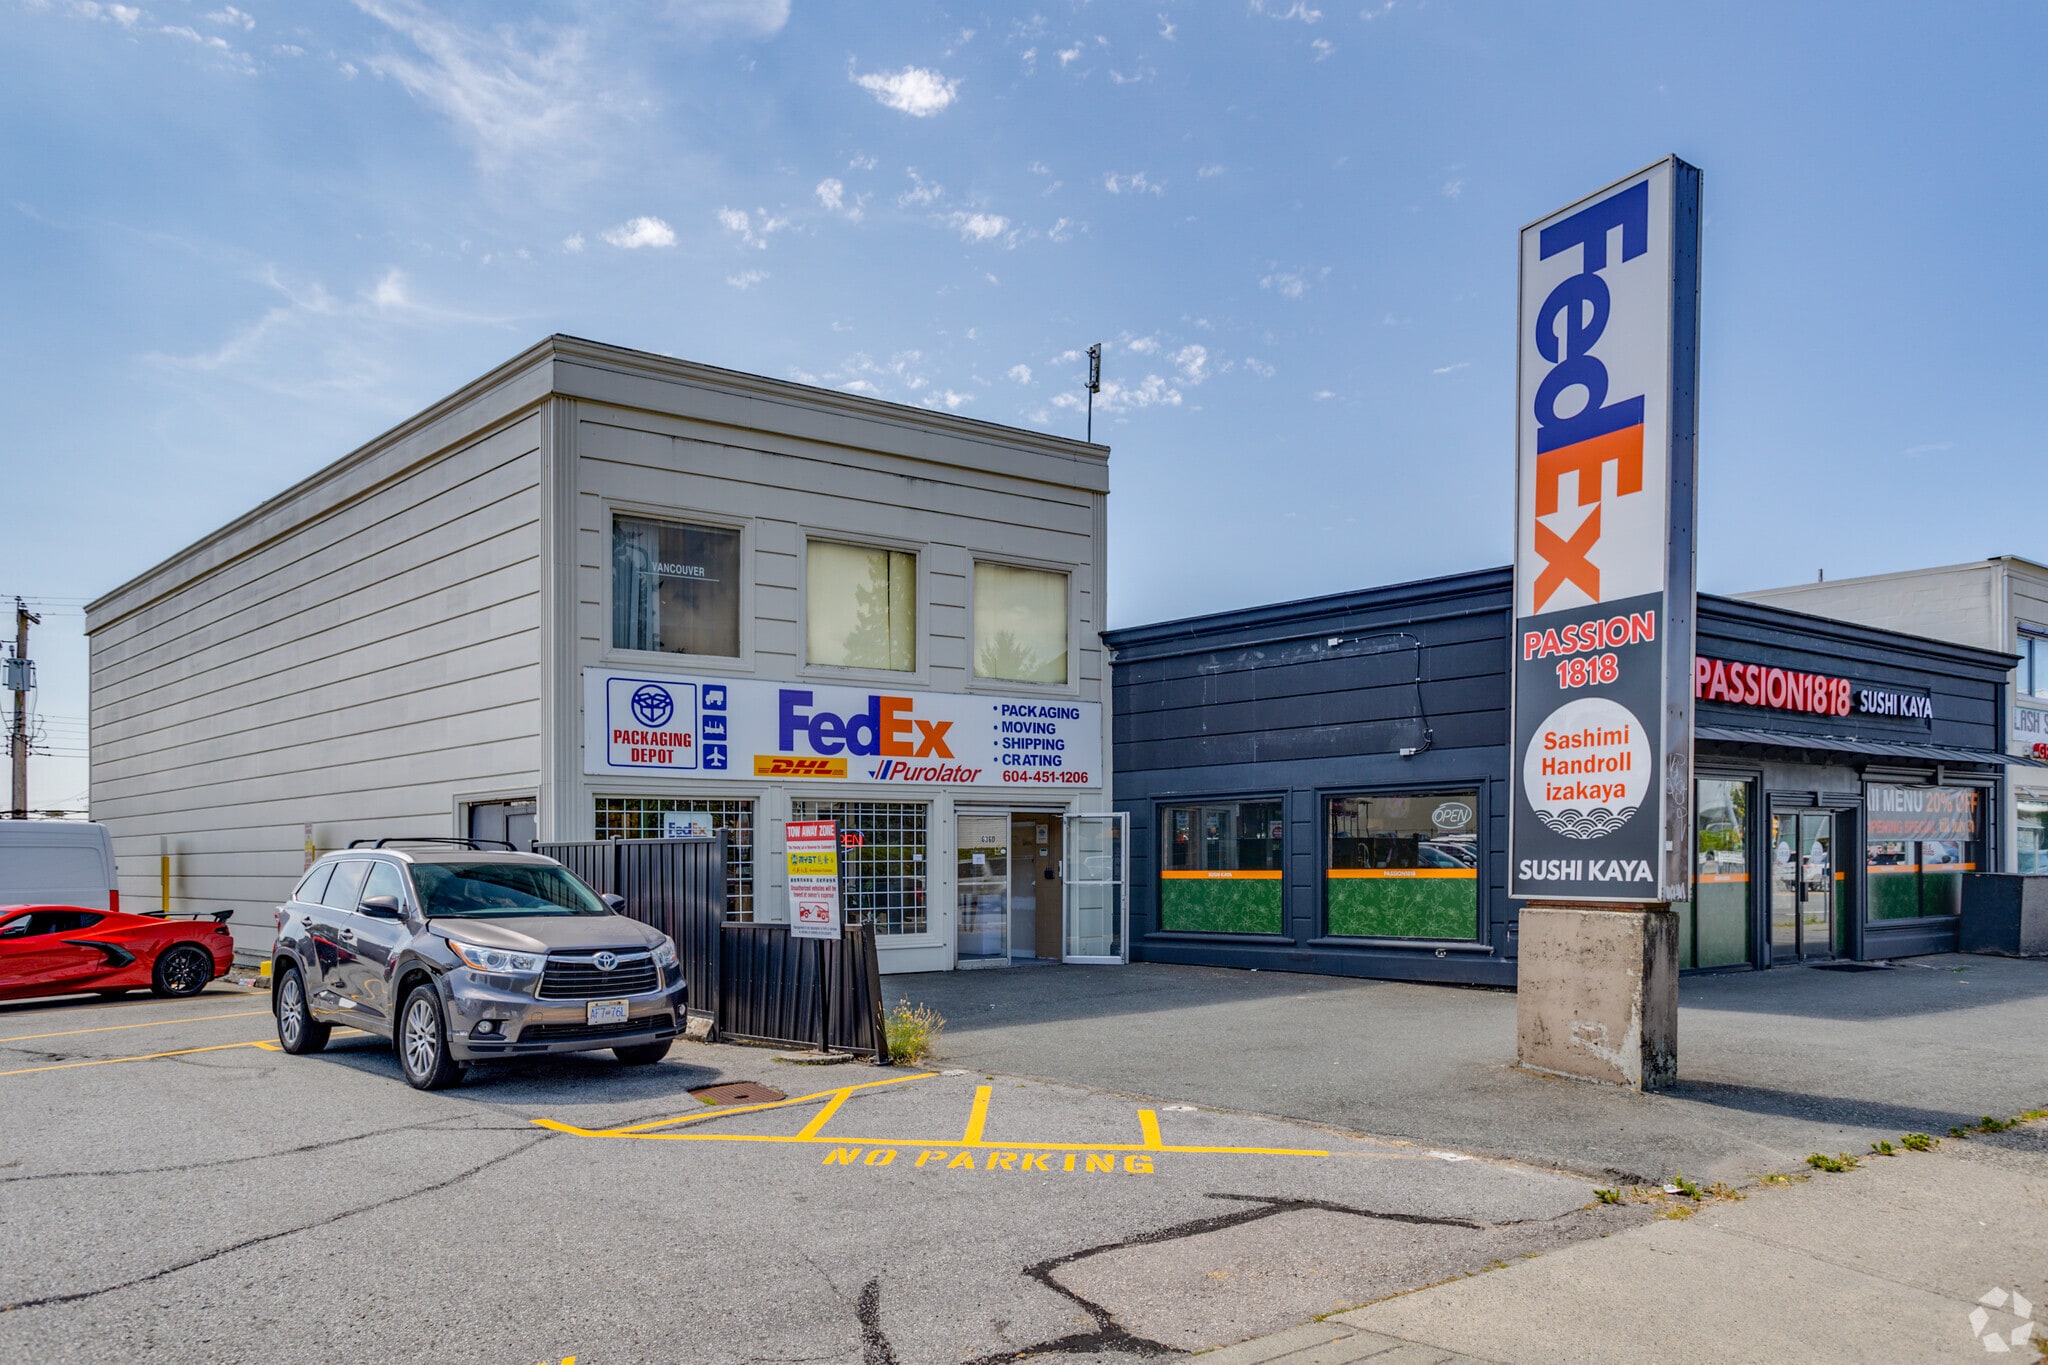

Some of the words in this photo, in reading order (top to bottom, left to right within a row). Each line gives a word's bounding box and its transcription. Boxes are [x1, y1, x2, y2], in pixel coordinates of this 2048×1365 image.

[1533, 179, 1649, 616] FedEx
[652, 561, 705, 577] VANCOUVER
[1524, 610, 1655, 660] PASSION
[1556, 653, 1619, 689] 1818
[1695, 656, 1851, 717] PASSION1818
[1860, 689, 1898, 716] SUSHI
[1900, 695, 1933, 719] KAYA
[1001, 704, 1080, 720] PACKAGING
[2014, 709, 2040, 734] LASH
[779, 689, 955, 759] FedEx
[1001, 721, 1056, 735] MOVING
[613, 729, 692, 747] PACKAGING
[1002, 737, 1065, 751] SHIPPING
[1544, 724, 1630, 750] Sashimi
[631, 747, 674, 764] DEPOT
[1002, 753, 1062, 767] CRATING
[1541, 751, 1631, 776] Handroll
[770, 759, 832, 775] DHL
[889, 761, 983, 783] Purolator
[1003, 770, 1089, 783] 604-451-1206
[1546, 780, 1626, 803] izakaya
[1883, 789, 1924, 813] MENU
[1926, 791, 1953, 813] 20%
[1955, 791, 1979, 814] OFF
[1434, 808, 1469, 823] OPEN
[668, 821, 708, 836] FedEx
[788, 826, 801, 837] TOW
[802, 825, 817, 837] AWAY
[818, 824, 835, 836] ZONE
[1518, 859, 1582, 881] SUSHI
[1588, 859, 1654, 882] KAYA
[822, 1147, 898, 1166] NO
[914, 1149, 1155, 1174] PARKING
